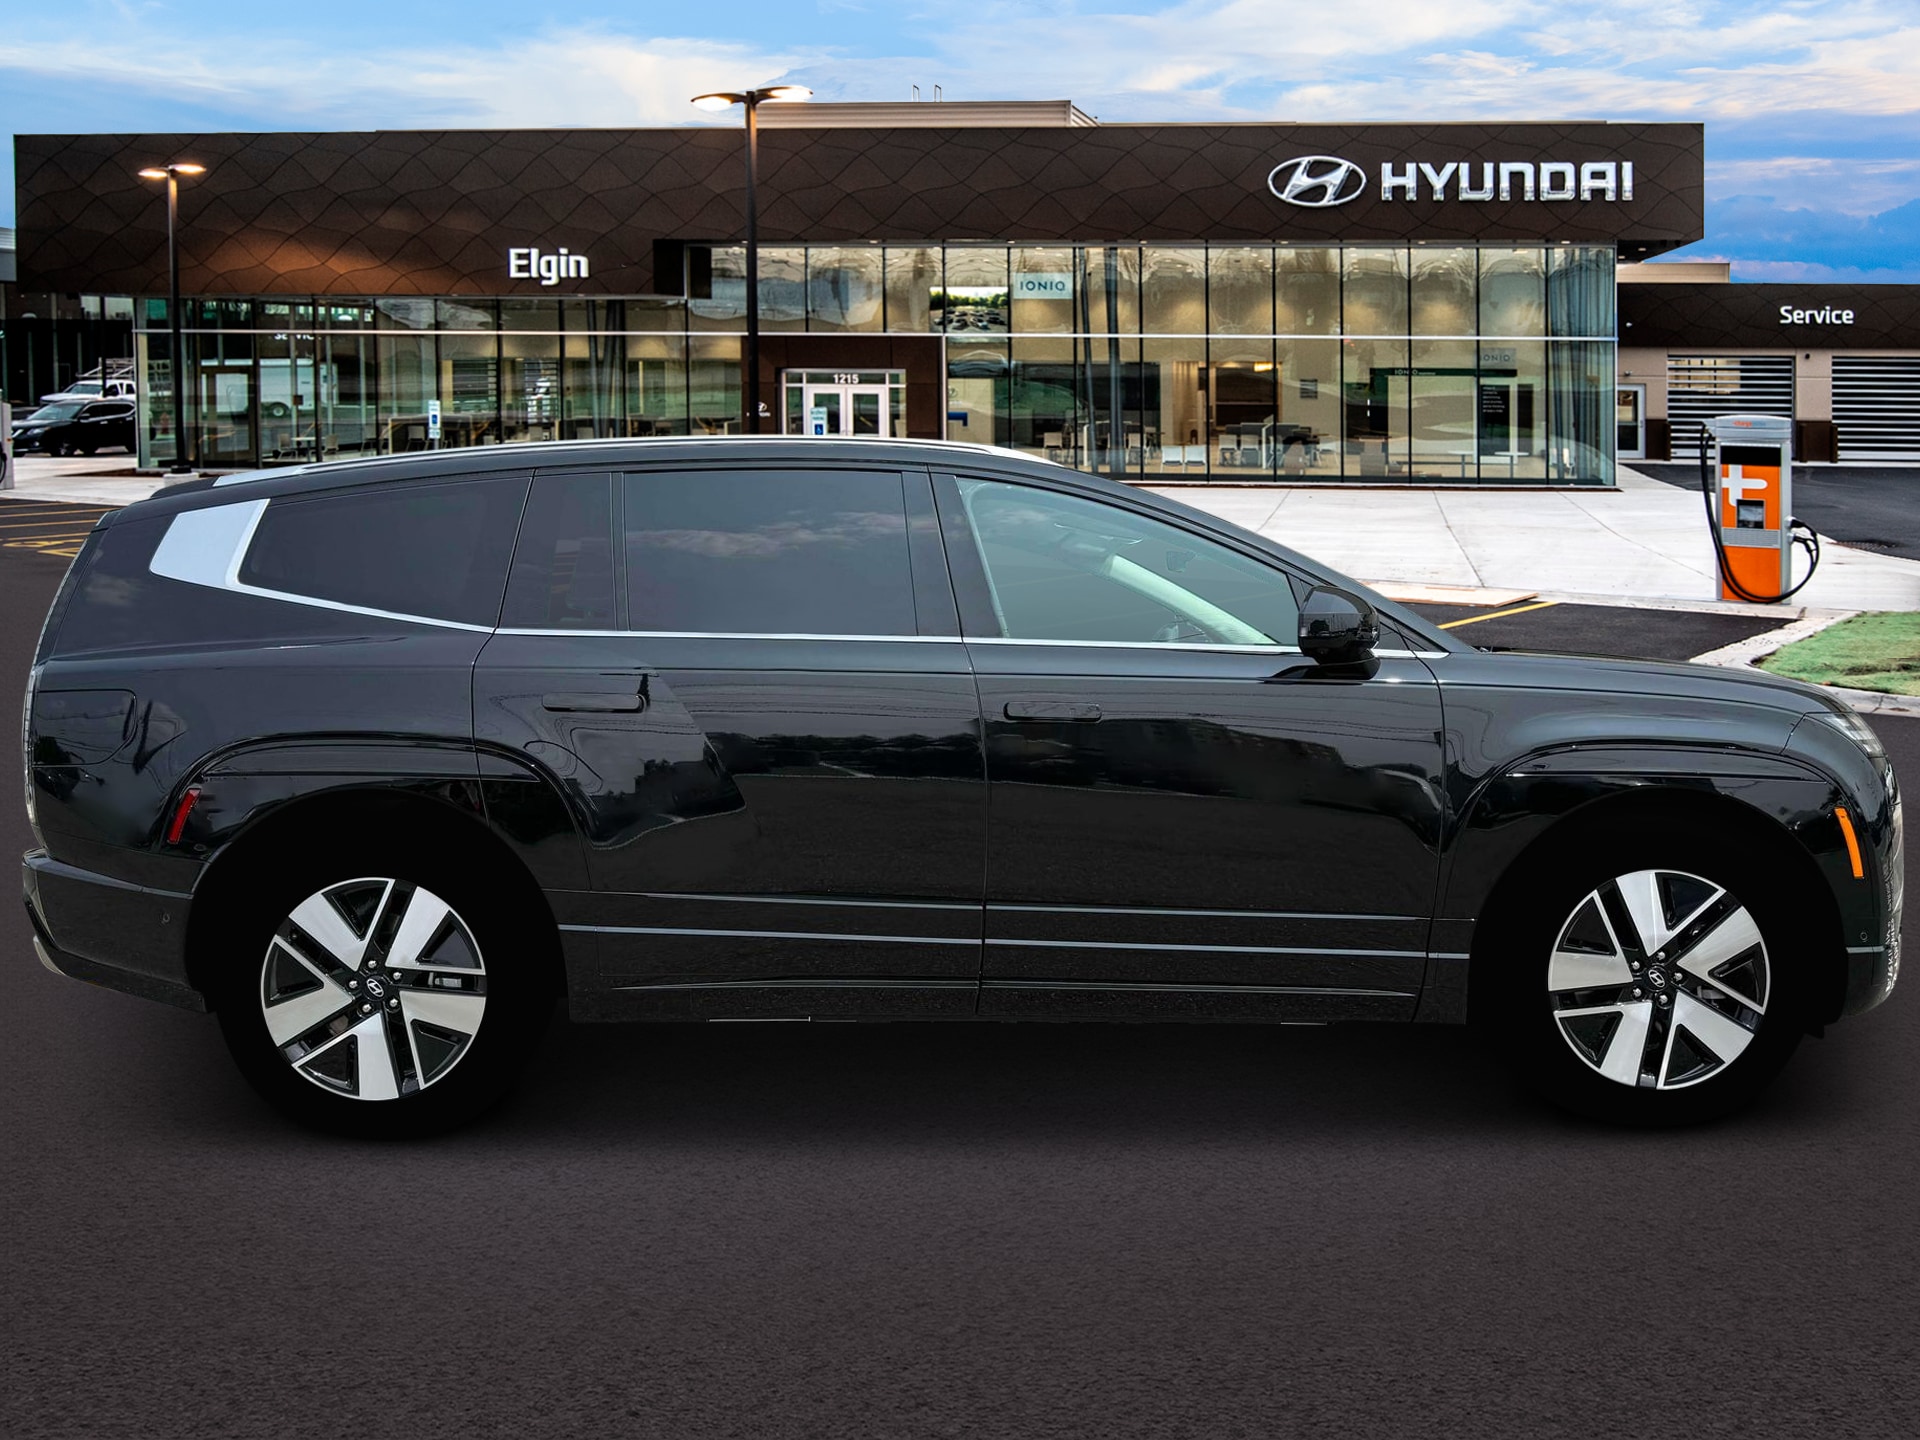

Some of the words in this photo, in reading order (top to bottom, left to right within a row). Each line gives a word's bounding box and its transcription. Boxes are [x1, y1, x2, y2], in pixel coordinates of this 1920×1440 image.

[1380, 161, 1634, 201] HYUNDAI
[508, 247, 590, 286] Elgin
[1020, 280, 1066, 292] IONIQ
[1779, 305, 1855, 325] Service
[833, 373, 860, 384] 1215
